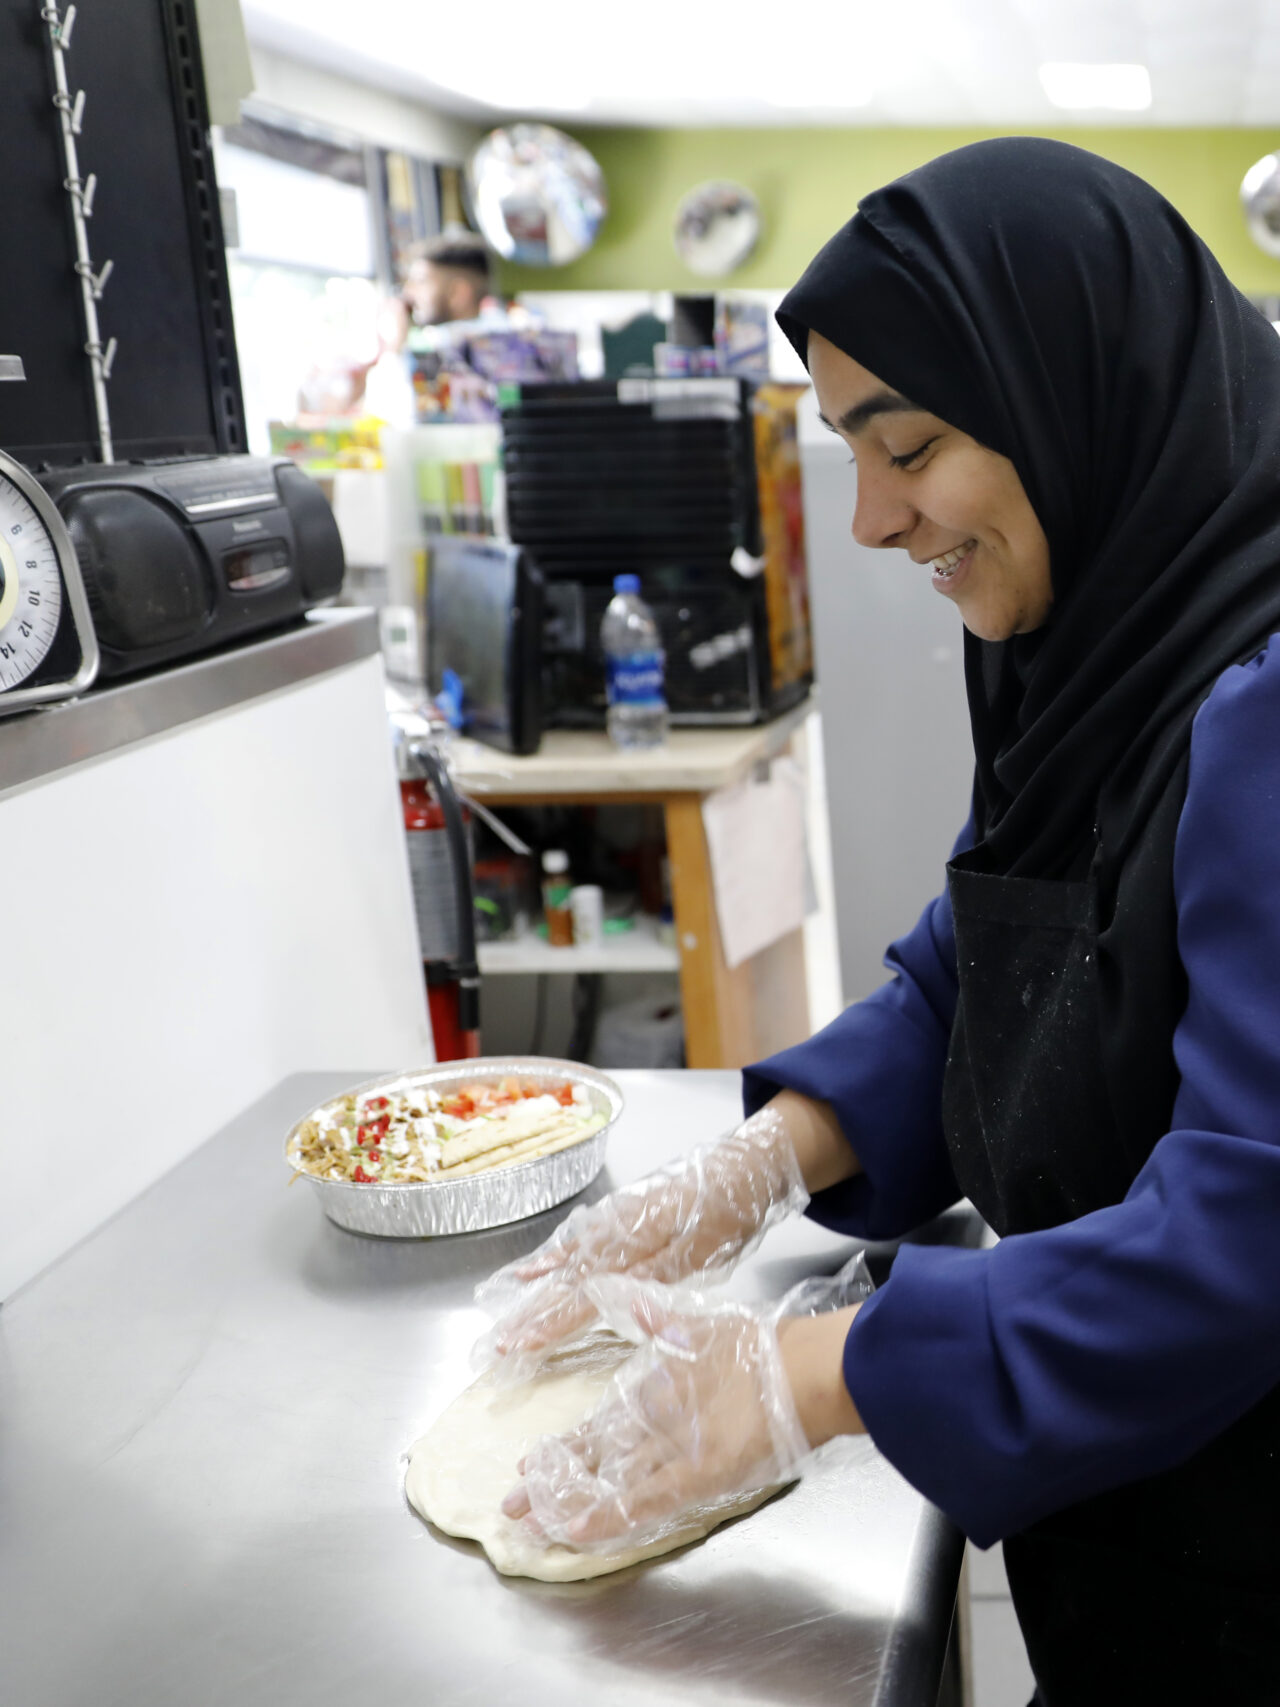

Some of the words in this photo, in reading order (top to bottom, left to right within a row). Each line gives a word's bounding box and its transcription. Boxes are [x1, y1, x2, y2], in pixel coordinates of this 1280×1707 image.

[11, 524, 22, 536] 6
[26, 560, 37, 569] 8
[28, 590, 40, 607] 10
[18, 620, 33, 638] 12
[0, 642, 16, 659] 14
